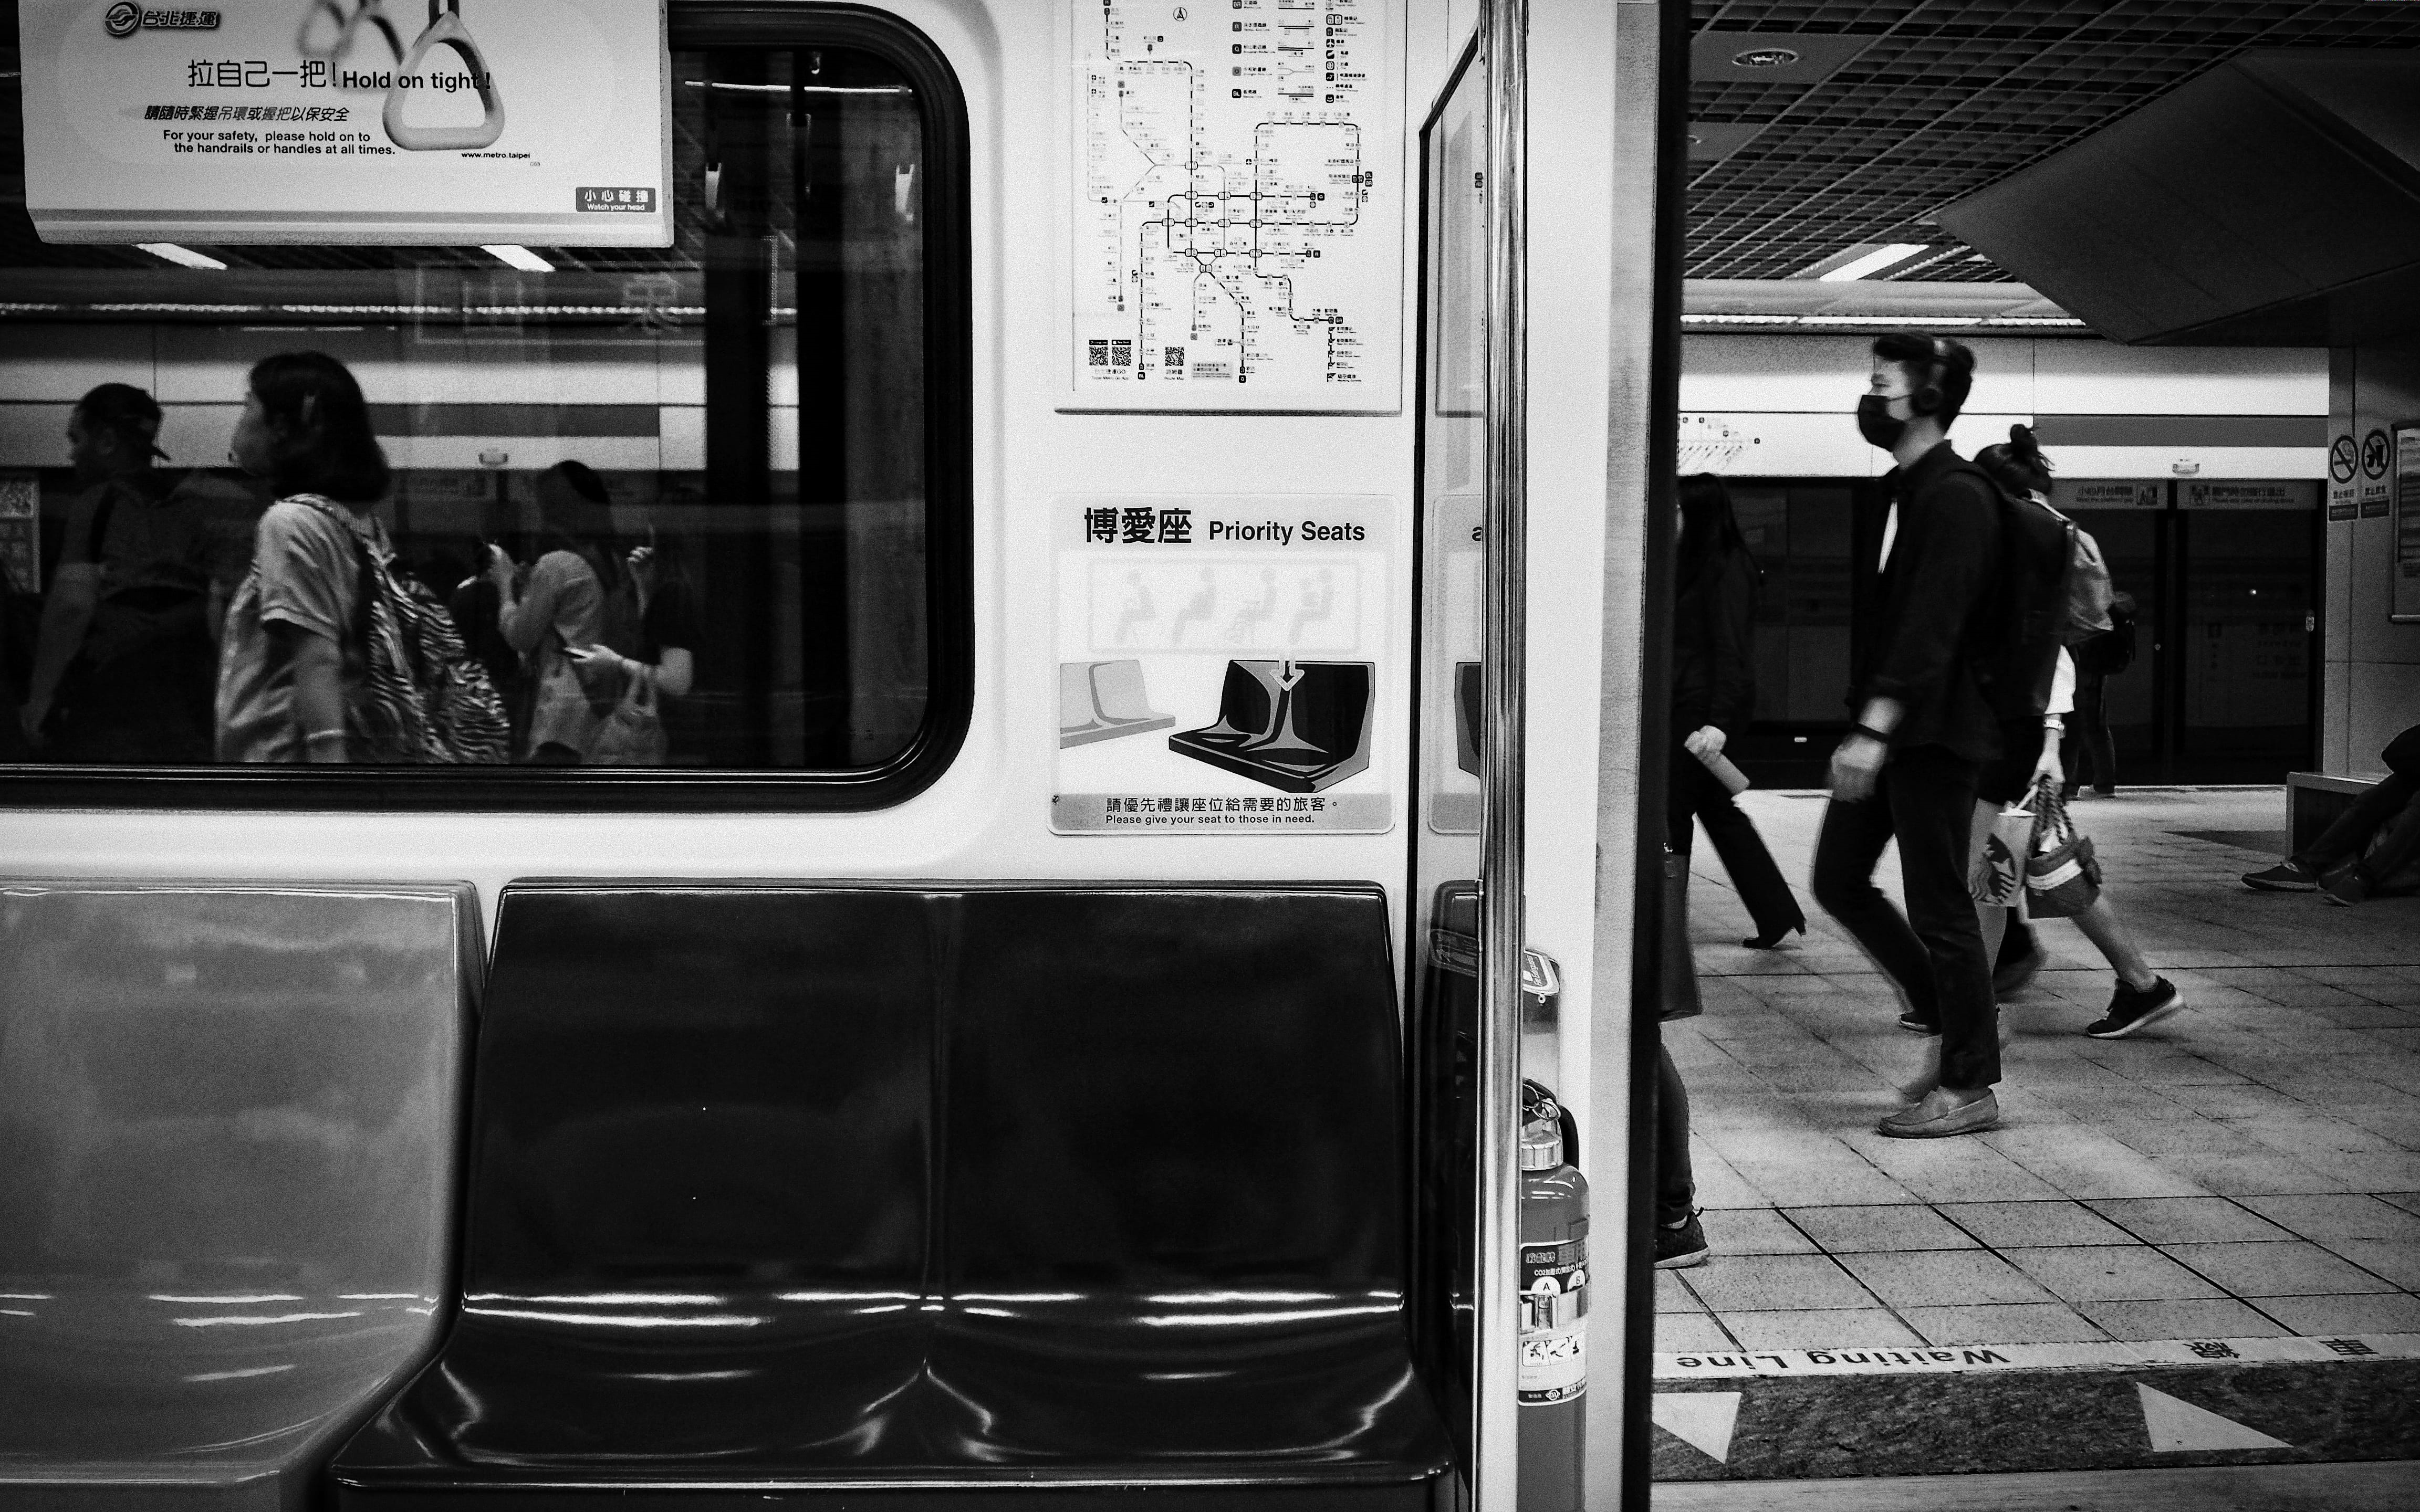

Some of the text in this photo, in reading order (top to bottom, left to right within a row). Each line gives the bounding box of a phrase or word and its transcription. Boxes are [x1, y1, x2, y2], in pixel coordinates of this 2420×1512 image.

[142, 10, 217, 27] 台北捷運
[343, 71, 391, 88] Hold
[398, 76, 424, 88] on
[163, 130, 370, 142] For your safety, please hold on to
[174, 143, 193, 152] the
[197, 143, 253, 153] handrails
[274, 144, 321, 154] handles
[326, 144, 337, 154] at
[341, 144, 354, 154] all
[359, 144, 395, 154] times.
[1084, 507, 1193, 544] 博愛座
[1209, 520, 1365, 546] Priority Seats
[1106, 815, 1142, 824] Please
[1145, 815, 1167, 825] give
[1171, 816, 1195, 825] your
[1198, 815, 1221, 824] seat
[1238, 815, 1269, 823] those
[1272, 814, 1281, 823] in
[1285, 814, 1315, 823] need.
[1676, 1348, 2011, 1370] Waiting Line
